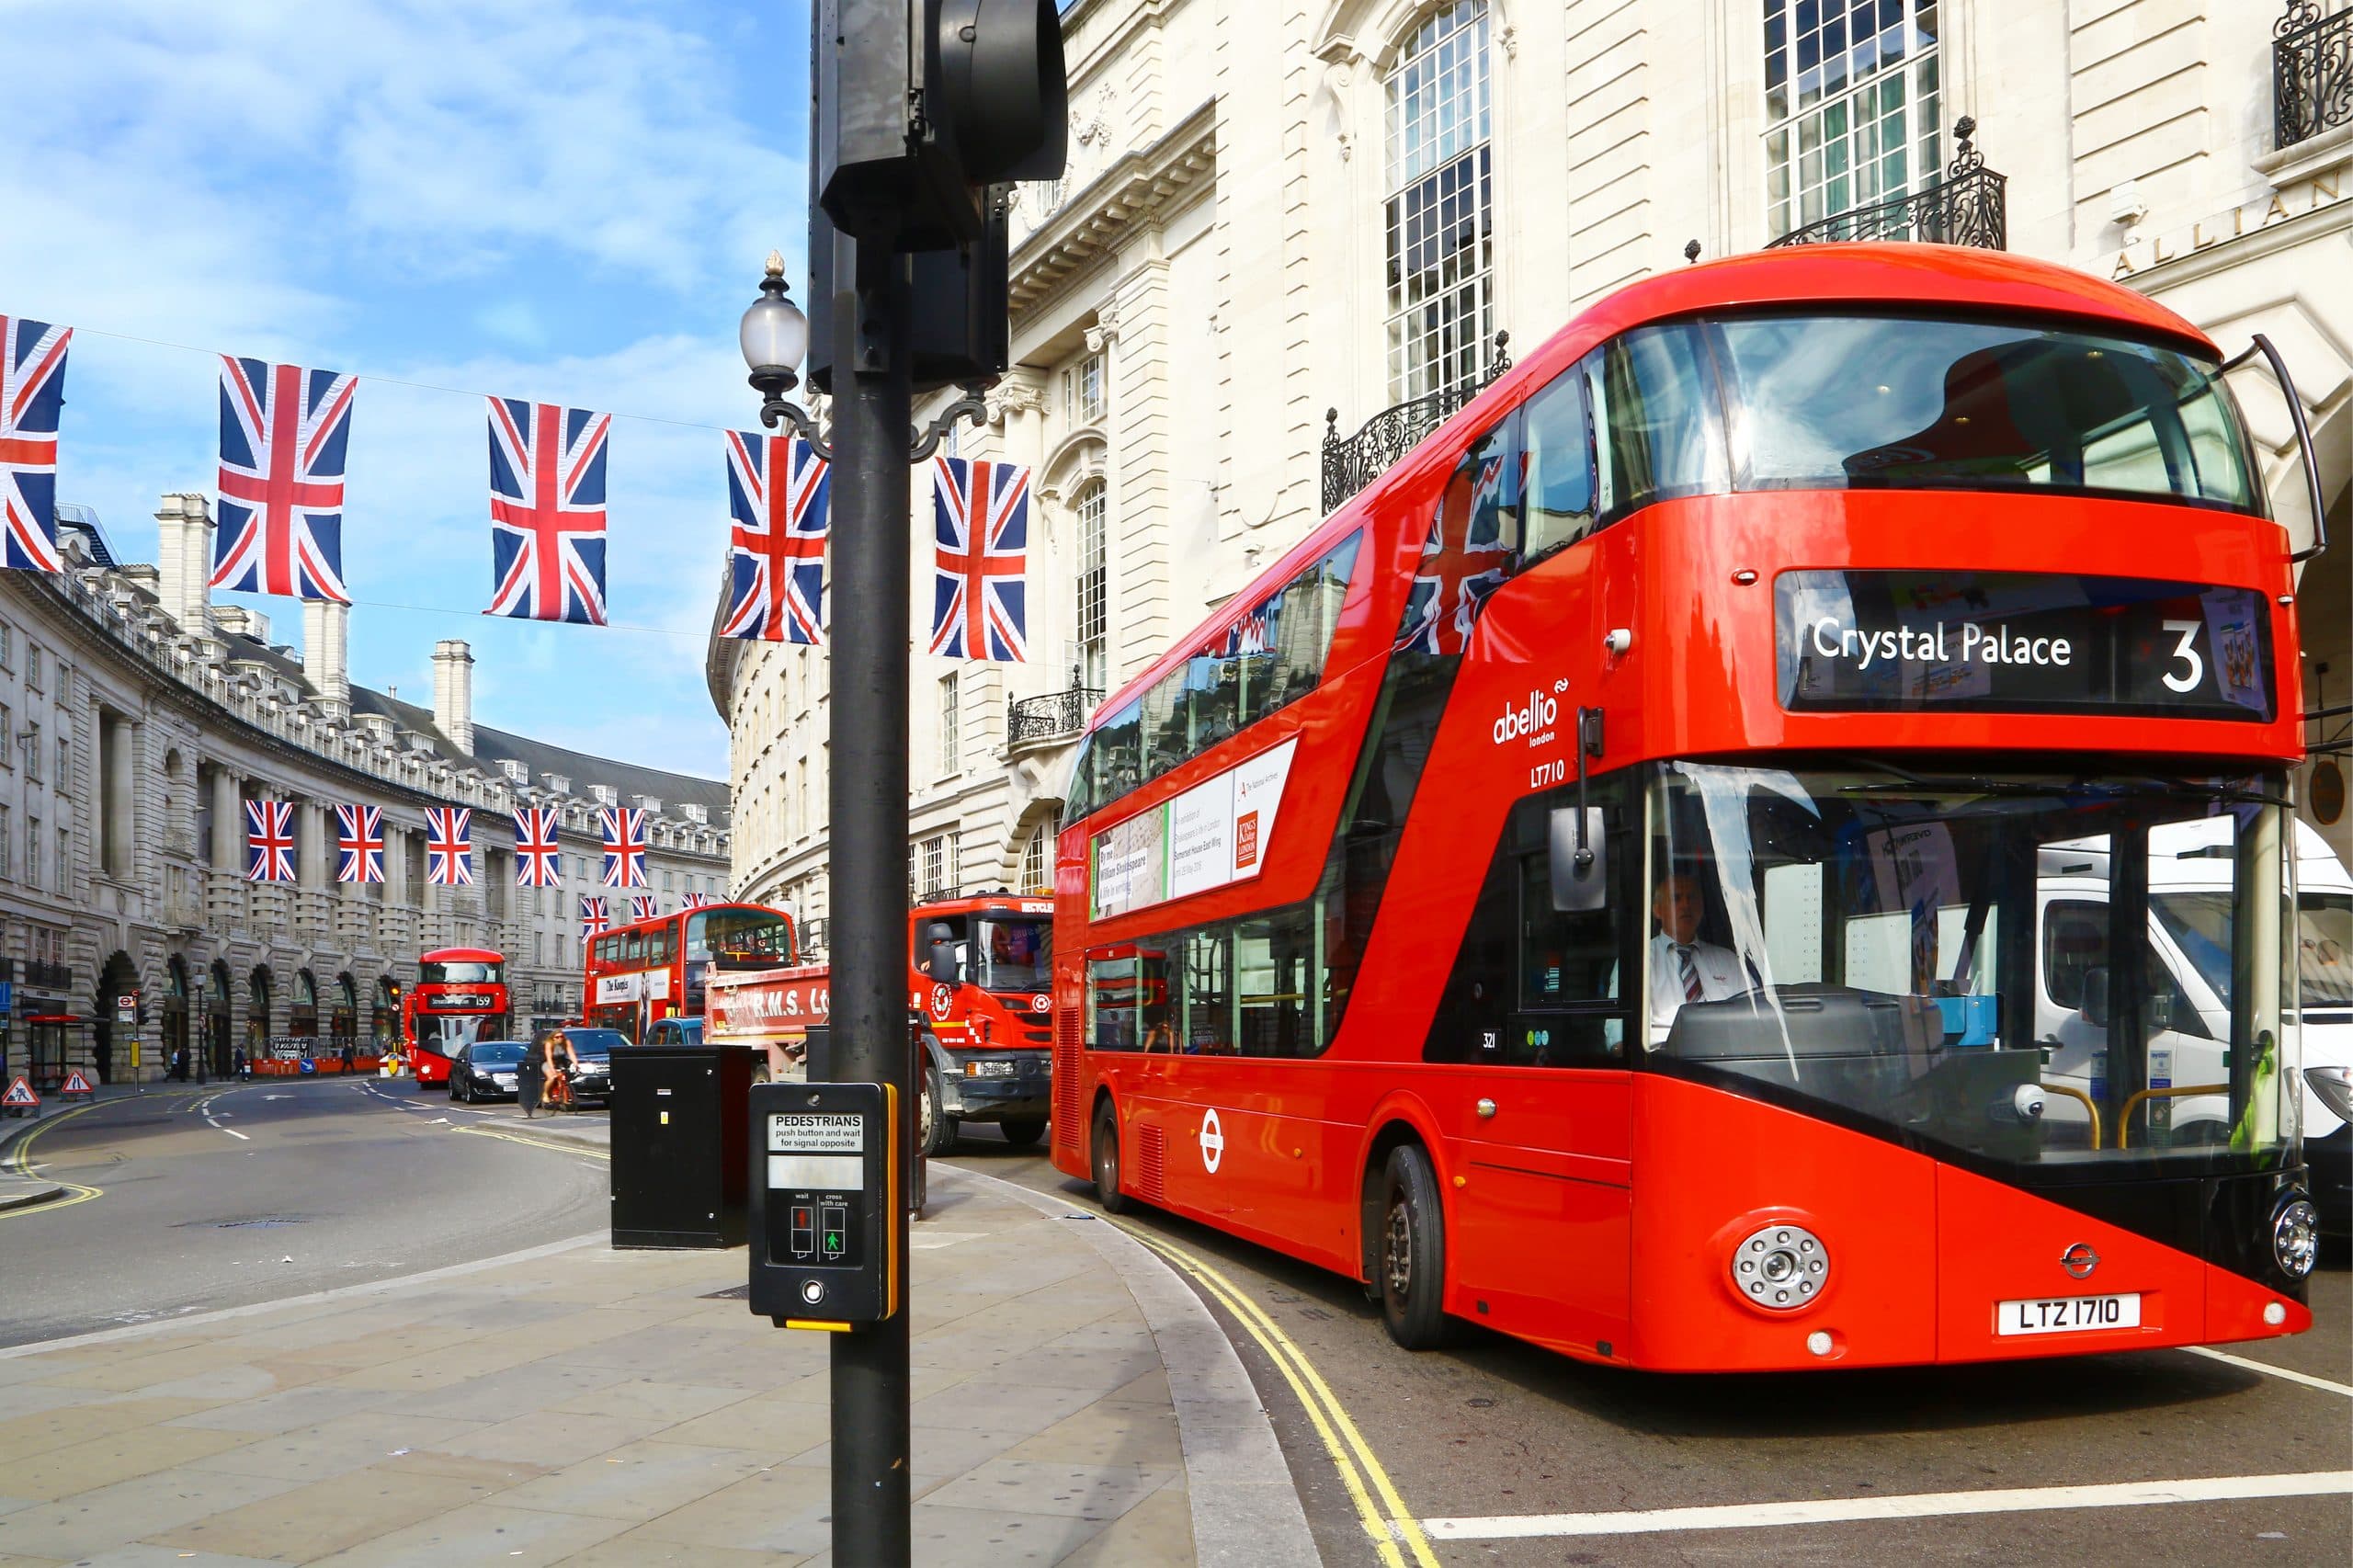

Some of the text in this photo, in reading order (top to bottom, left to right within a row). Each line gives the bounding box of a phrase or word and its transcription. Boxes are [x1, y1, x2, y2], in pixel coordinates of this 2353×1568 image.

[1813, 617, 2203, 694] Crystal Palace 3
[1493, 689, 1557, 745] abellio
[1529, 731, 1555, 748] london
[1530, 759, 1565, 789] LT710
[1191, 844, 1203, 855] House
[1238, 841, 1256, 856] LONDON
[1021, 903, 1054, 914] RECYCLE
[476, 996, 491, 1006] 159
[753, 989, 804, 1017] R.M.S.
[810, 988, 829, 1015] Lt
[1483, 1032, 1495, 1049] 321
[776, 1116, 860, 1126] PEDESTRIANS
[776, 1129, 860, 1139] push button and wait
[780, 1138, 856, 1149] for signal opposite
[2019, 1298, 2120, 1329] LTZ 1710
